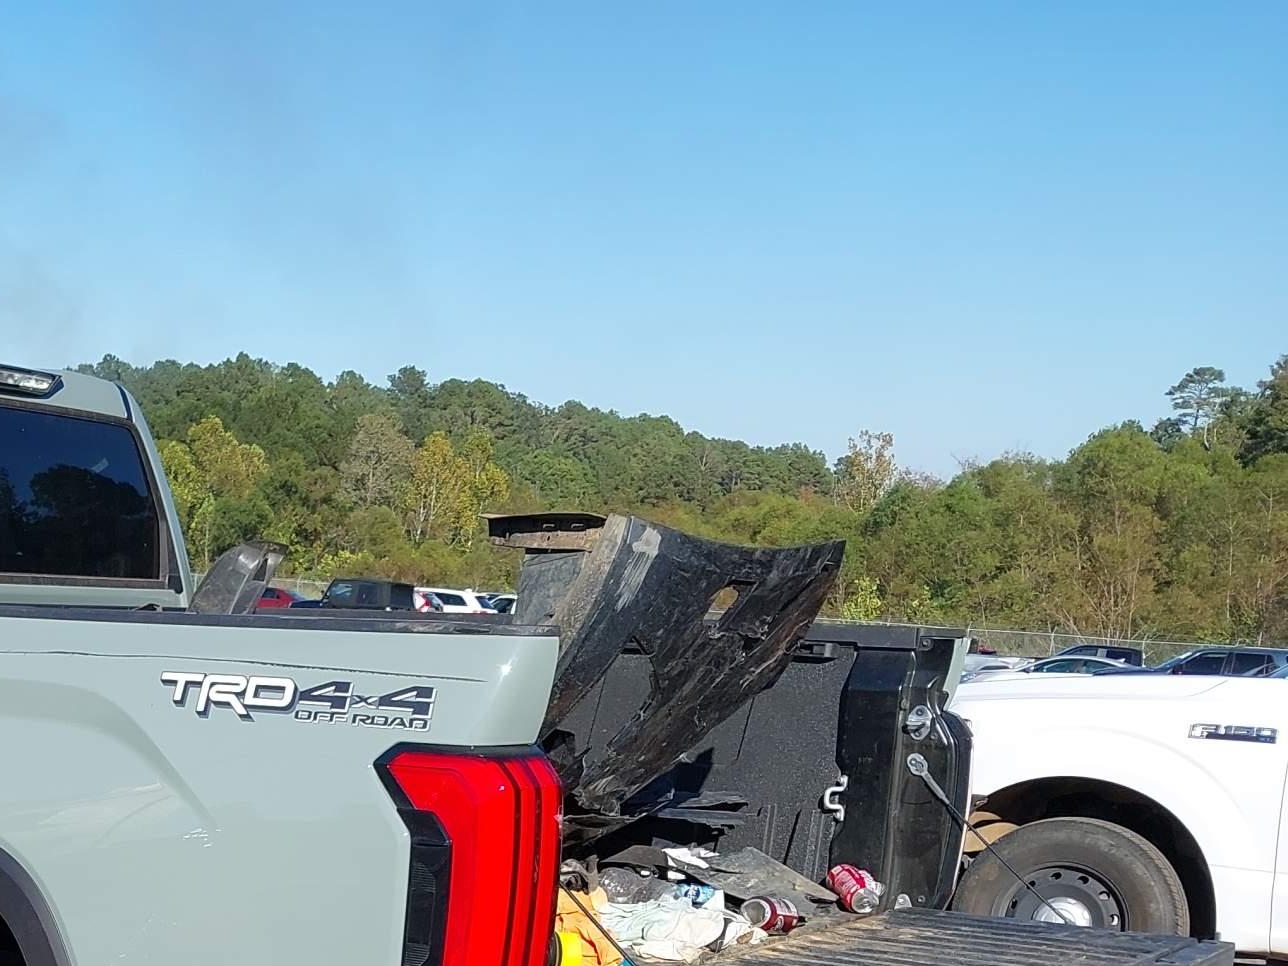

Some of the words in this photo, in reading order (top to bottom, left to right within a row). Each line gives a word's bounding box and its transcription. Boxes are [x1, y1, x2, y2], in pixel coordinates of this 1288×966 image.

[160, 671, 298, 722] TRD
[294, 709, 350, 724] OFF
[351, 713, 431, 732] ROAD
